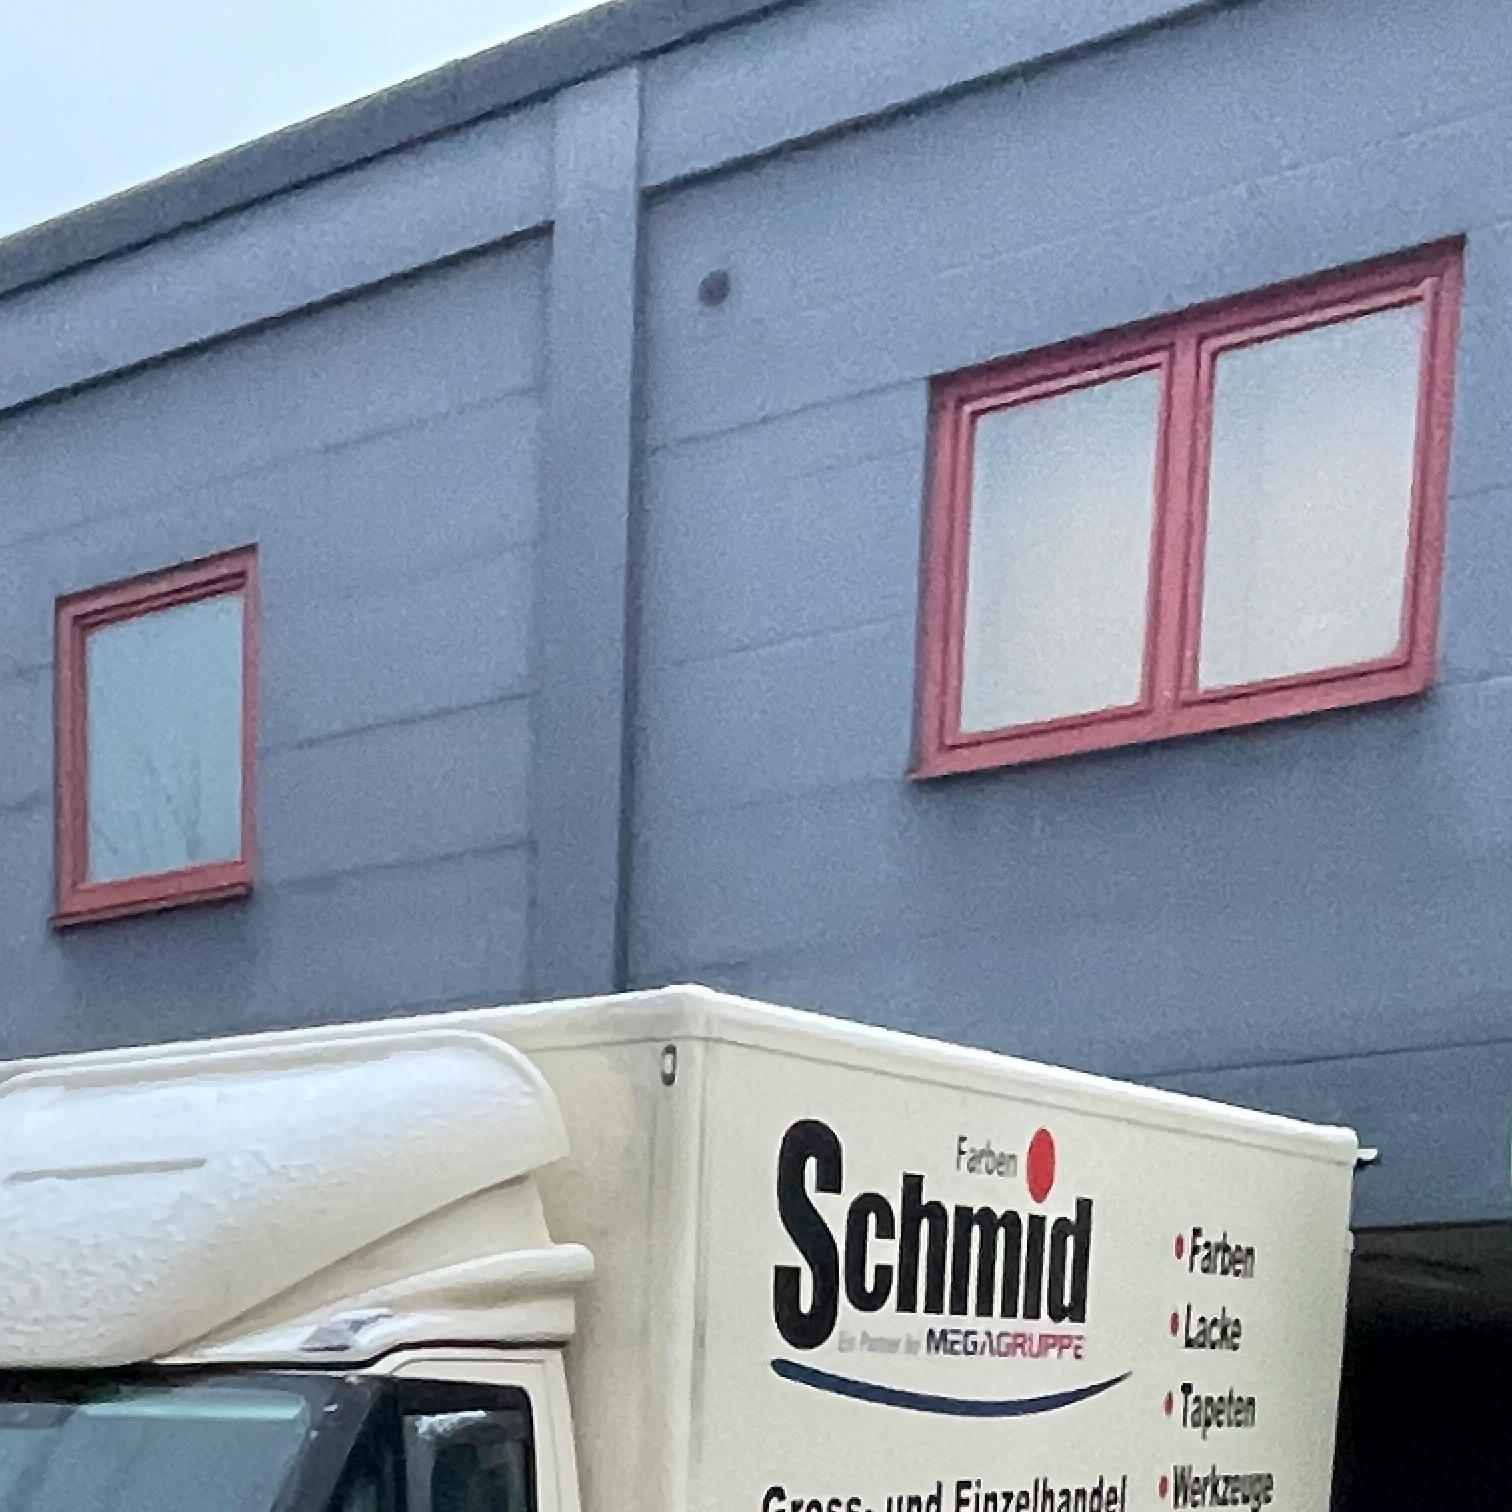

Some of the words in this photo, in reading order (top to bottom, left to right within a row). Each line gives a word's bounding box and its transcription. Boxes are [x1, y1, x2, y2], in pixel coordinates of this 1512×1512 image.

[956, 1134, 1018, 1178] Farben
[773, 1118, 1094, 1350] Schmid
[1188, 1226, 1256, 1279] Farben
[926, 1327, 1085, 1360] MEGAGRUPPE
[1184, 1301, 1242, 1351] Lacke
[1181, 1382, 1256, 1441] Tapeten
